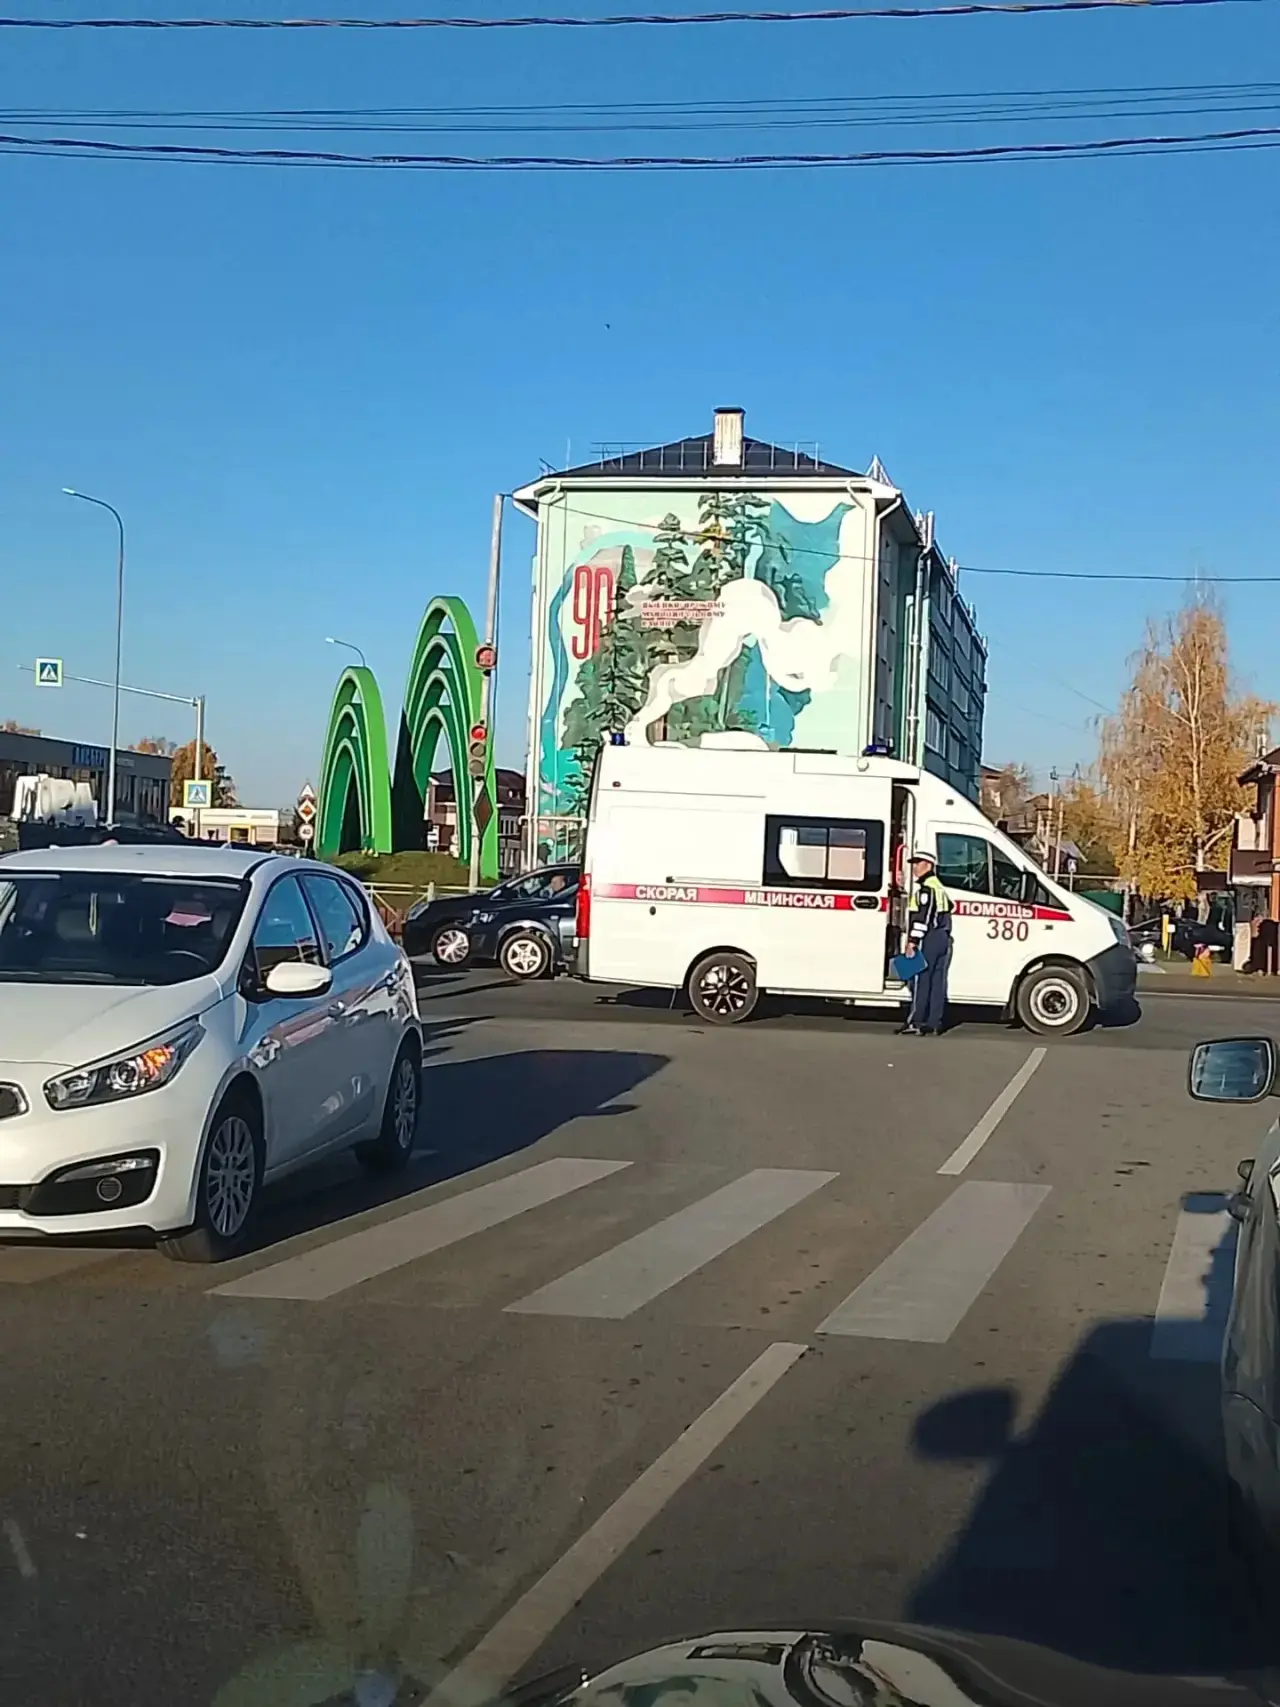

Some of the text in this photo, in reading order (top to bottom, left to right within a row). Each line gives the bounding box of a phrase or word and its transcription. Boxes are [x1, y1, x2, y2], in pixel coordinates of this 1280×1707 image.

[635, 885, 698, 902] СКОРАЯ
[959, 901, 1034, 919] ПОМОЩЬ
[986, 919, 1029, 942] 380
